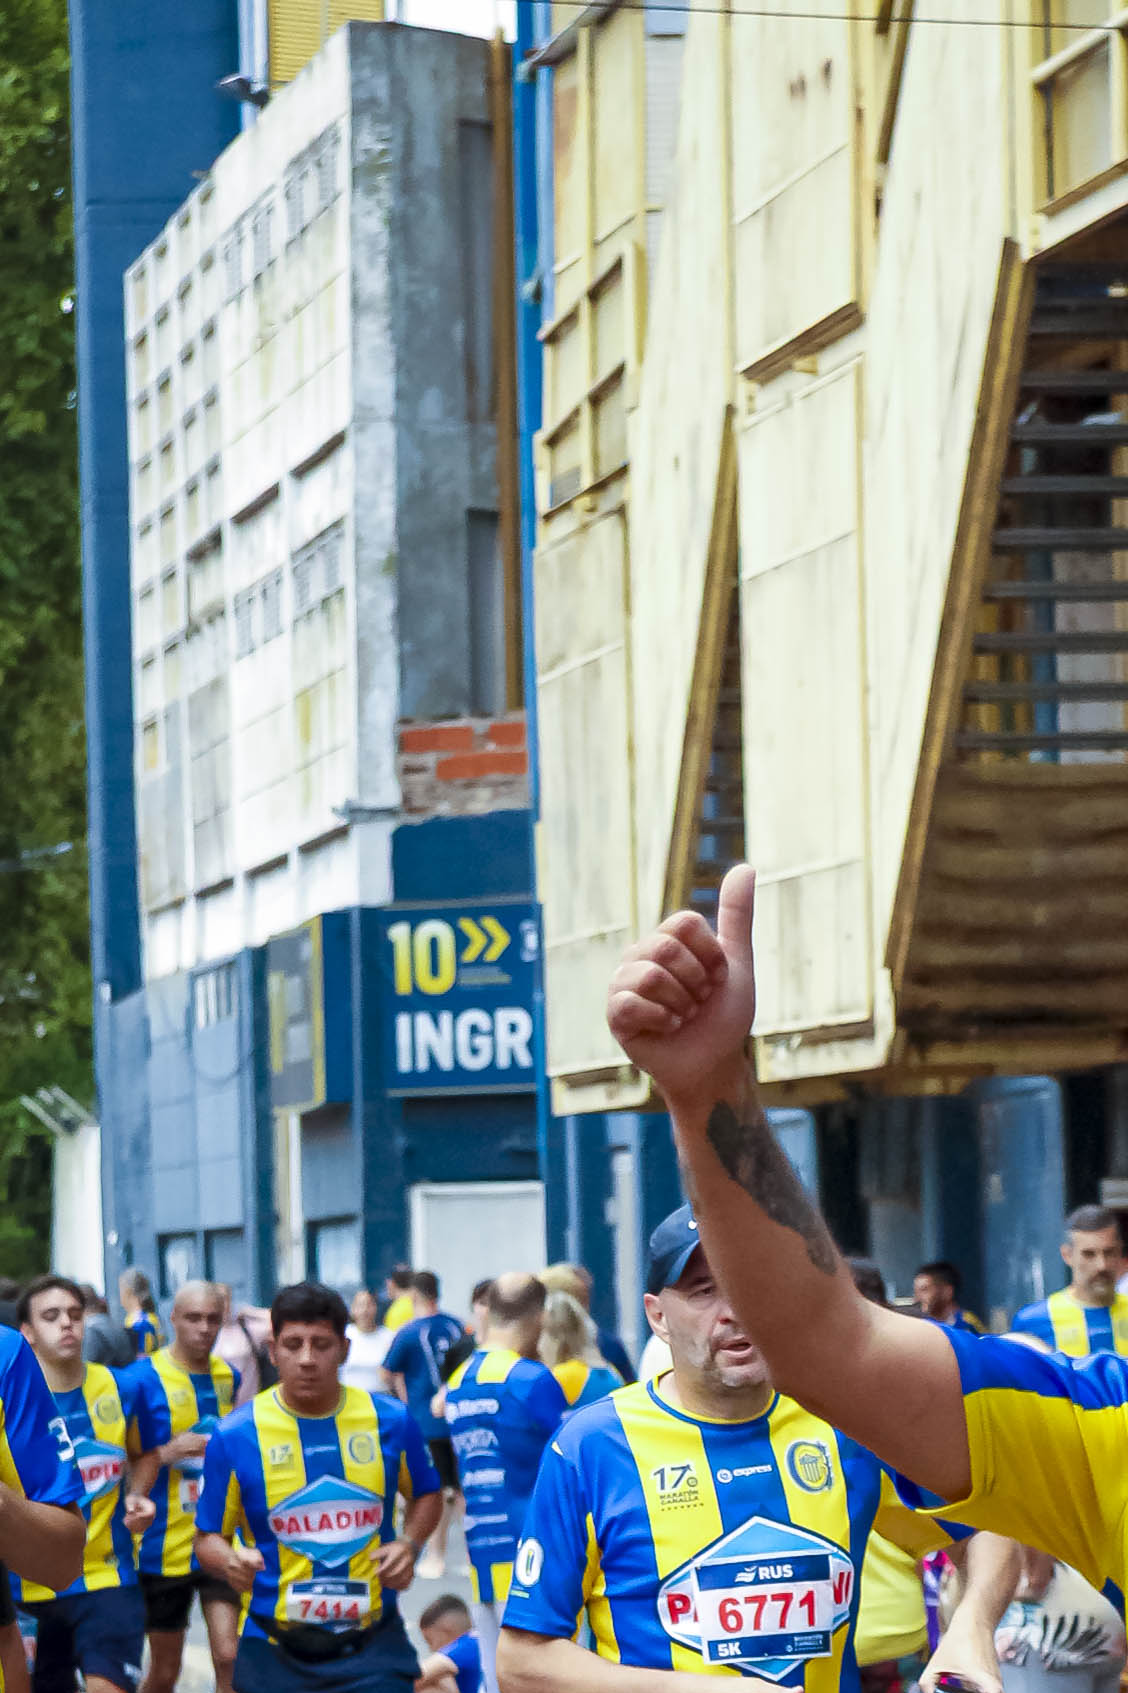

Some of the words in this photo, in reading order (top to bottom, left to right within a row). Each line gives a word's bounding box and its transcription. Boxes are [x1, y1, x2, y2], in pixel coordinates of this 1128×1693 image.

[387, 919, 456, 995] 10
[396, 1006, 534, 1073] INGR
[653, 1464, 692, 1490] 17
[758, 1564, 794, 1580] RUS
[301, 1600, 359, 1620] 7414
[718, 1590, 815, 1634] 6771
[717, 1641, 742, 1657] 5K
